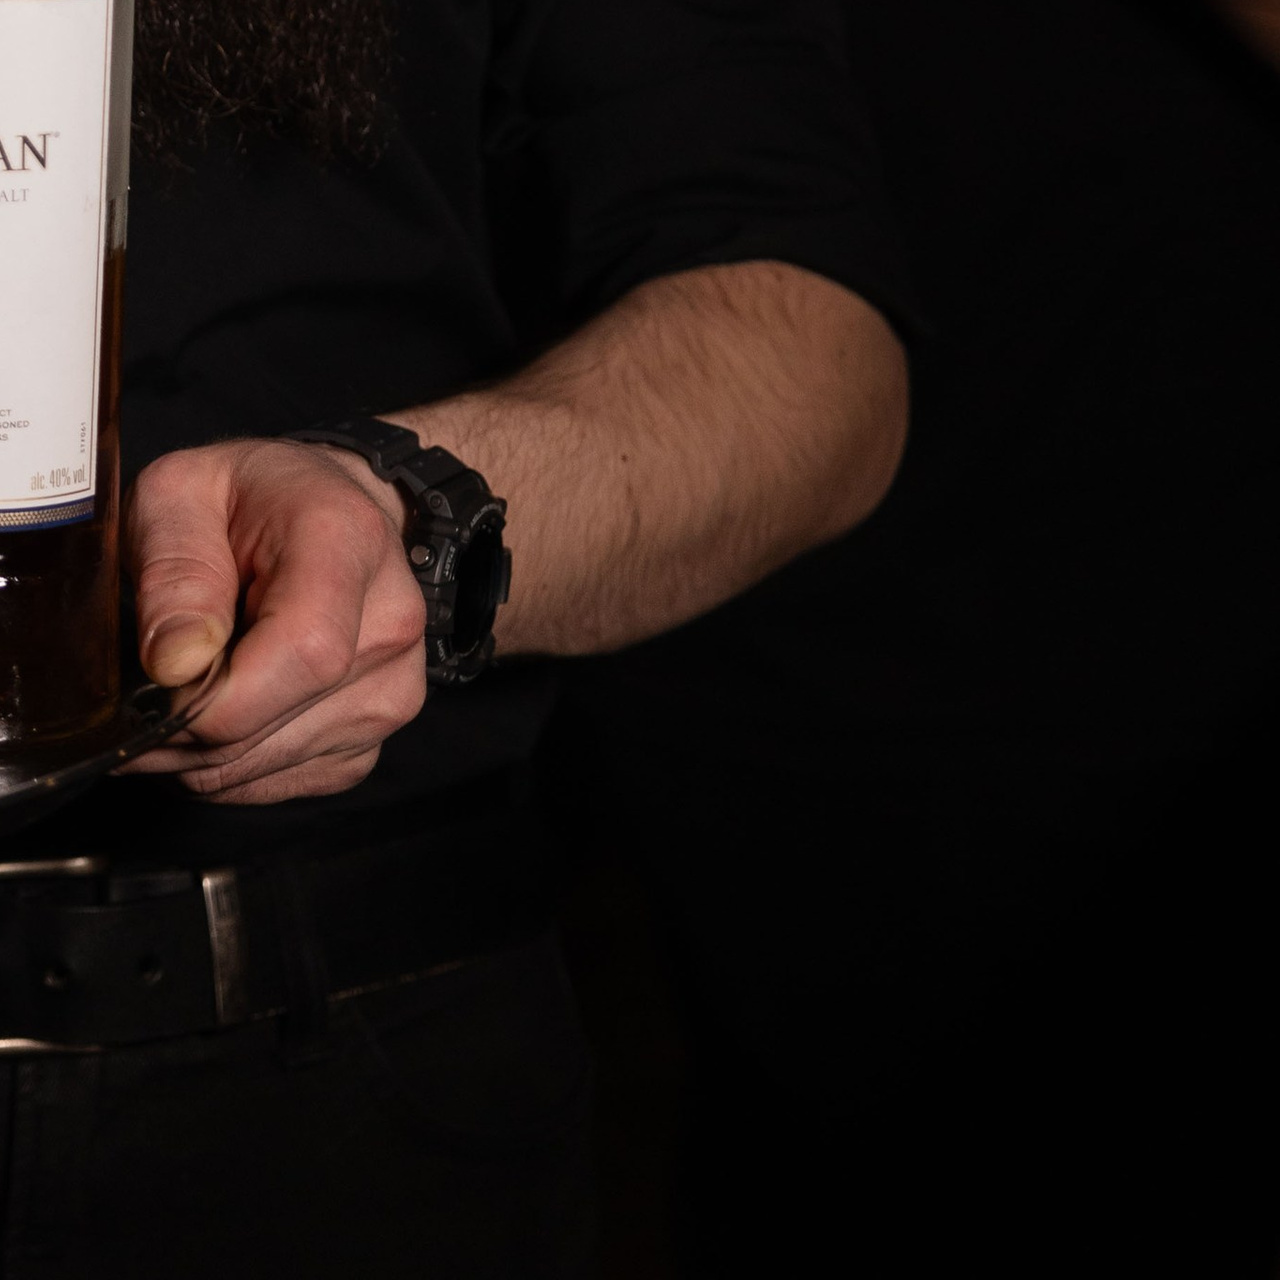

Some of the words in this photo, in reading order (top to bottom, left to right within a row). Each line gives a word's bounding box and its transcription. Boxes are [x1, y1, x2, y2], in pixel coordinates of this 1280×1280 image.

[31, 471, 48, 491] alc.
[49, 467, 71, 488] 40%
[73, 463, 87, 484] vol.
